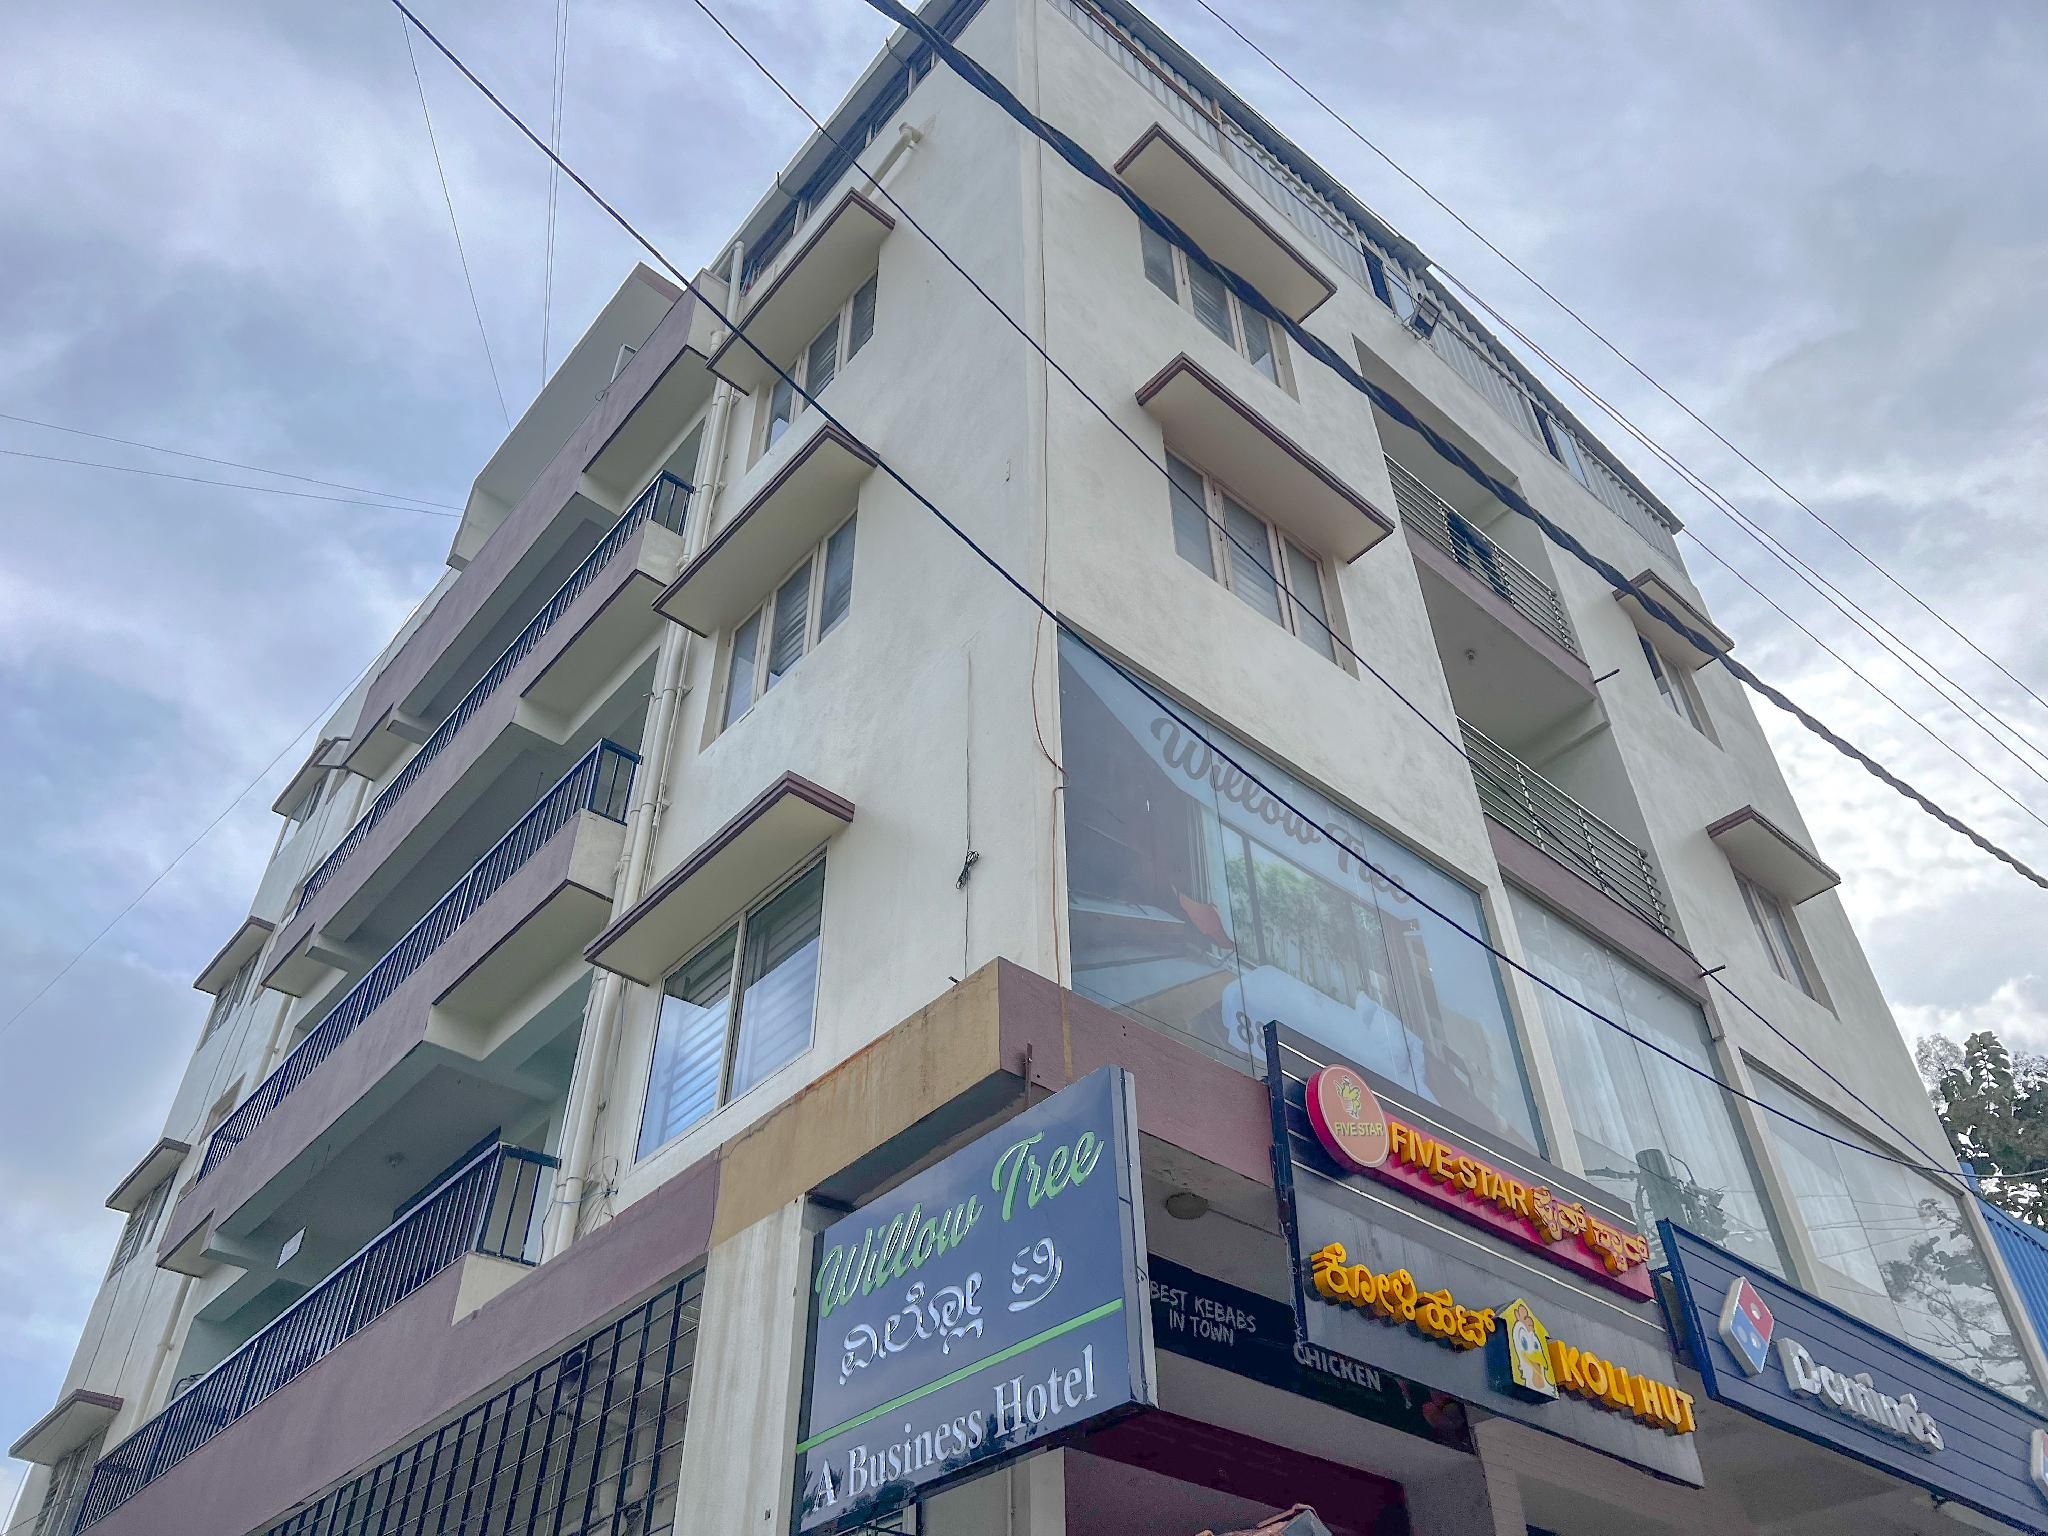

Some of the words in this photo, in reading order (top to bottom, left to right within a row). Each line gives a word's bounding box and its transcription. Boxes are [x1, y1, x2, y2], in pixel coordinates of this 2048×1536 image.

[1150, 717, 1322, 846] Willow
[1324, 822, 1411, 904] Tree
[1335, 1120, 1358, 1137] FIVE
[1358, 1122, 1384, 1137] STAR
[1390, 1121, 1455, 1180] FIVE
[1456, 1155, 1530, 1217] STAR
[815, 1194, 984, 1318] Willow
[992, 1131, 1105, 1222] Tree
[1149, 1280, 1188, 1307] BEST
[1194, 1296, 1257, 1333] KEBABS
[1169, 1308, 1186, 1332] IN
[1189, 1315, 1236, 1347] TOWN
[1293, 1341, 1382, 1392] CHICKEN
[1549, 1340, 1635, 1408] KOLI
[1634, 1373, 1696, 1434] HUT
[812, 1459, 838, 1512] A
[847, 1409, 984, 1498] Business
[993, 1343, 1098, 1439] Hotel
